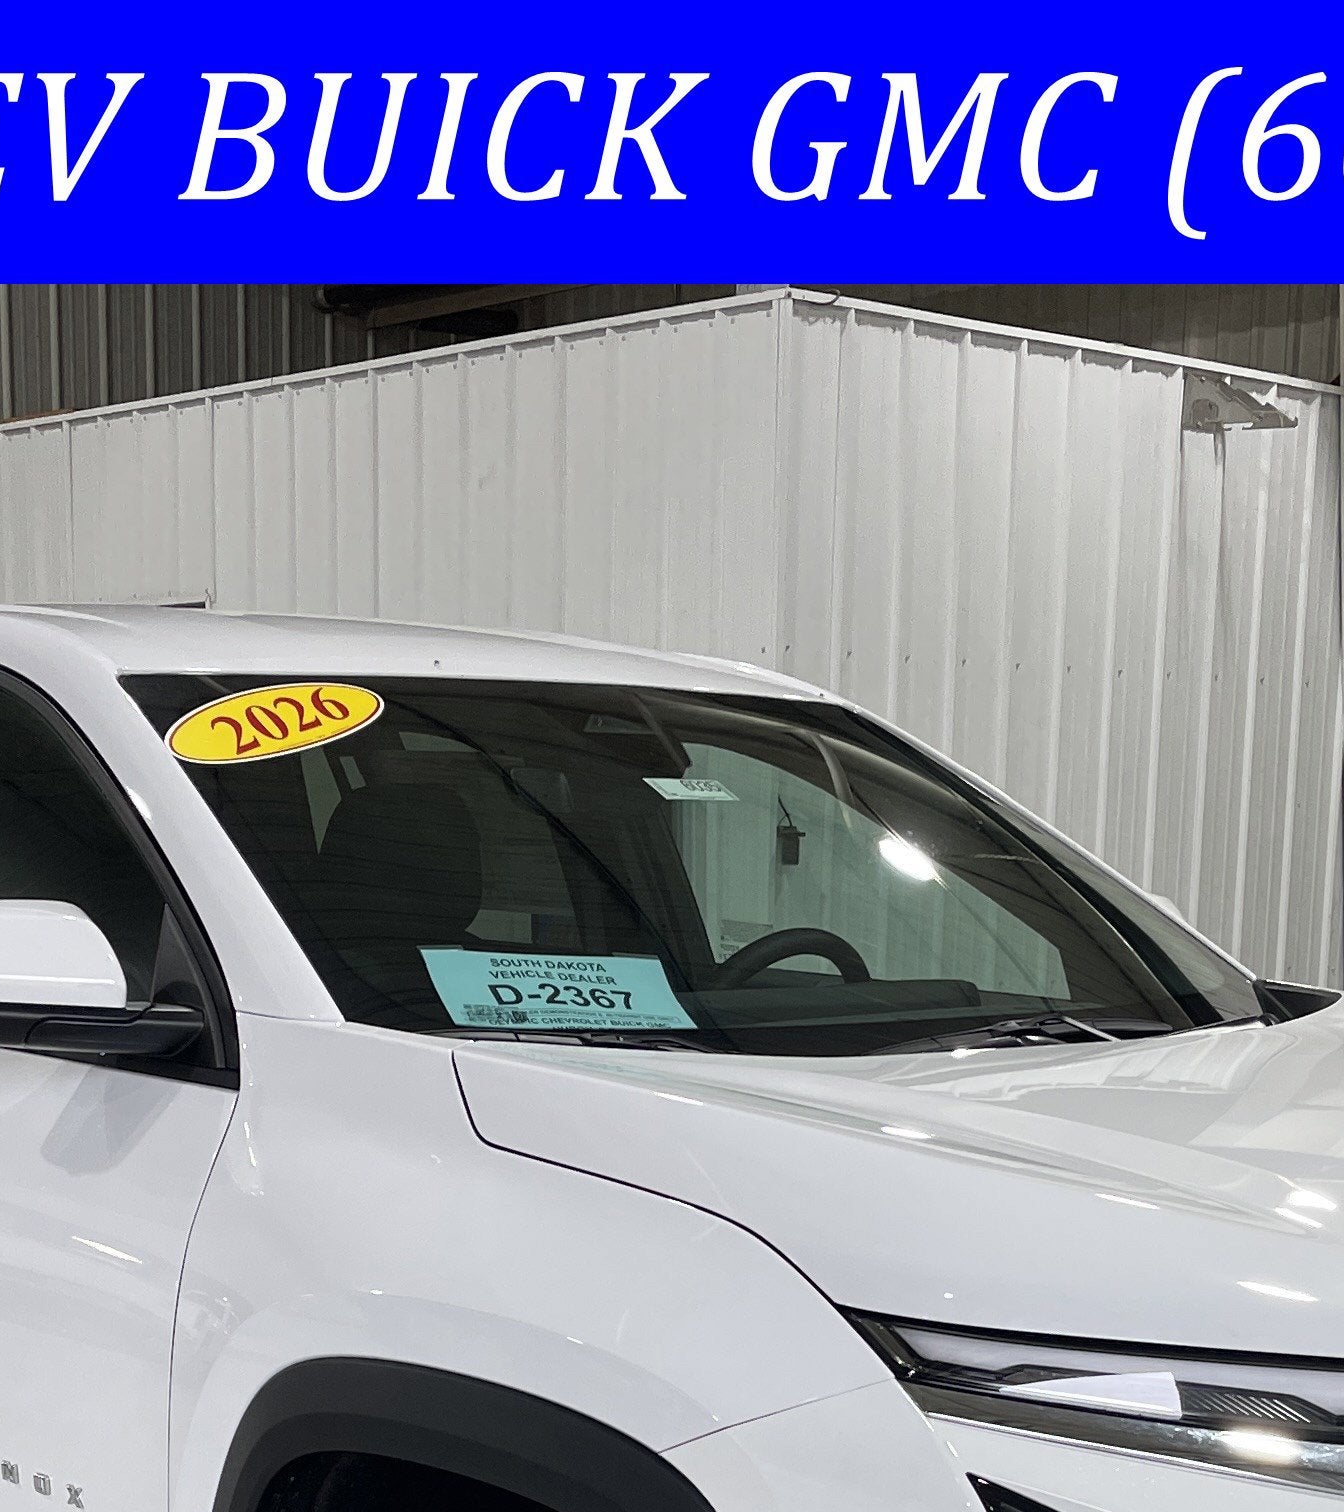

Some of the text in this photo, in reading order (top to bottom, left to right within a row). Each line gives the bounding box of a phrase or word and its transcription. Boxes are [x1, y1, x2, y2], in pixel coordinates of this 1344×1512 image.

[210, 686, 350, 756] 2026
[489, 958, 607, 973] SOUTH DAKOTA
[488, 969, 617, 986] VEHICLE DEALER
[487, 983, 633, 1010] D-2367
